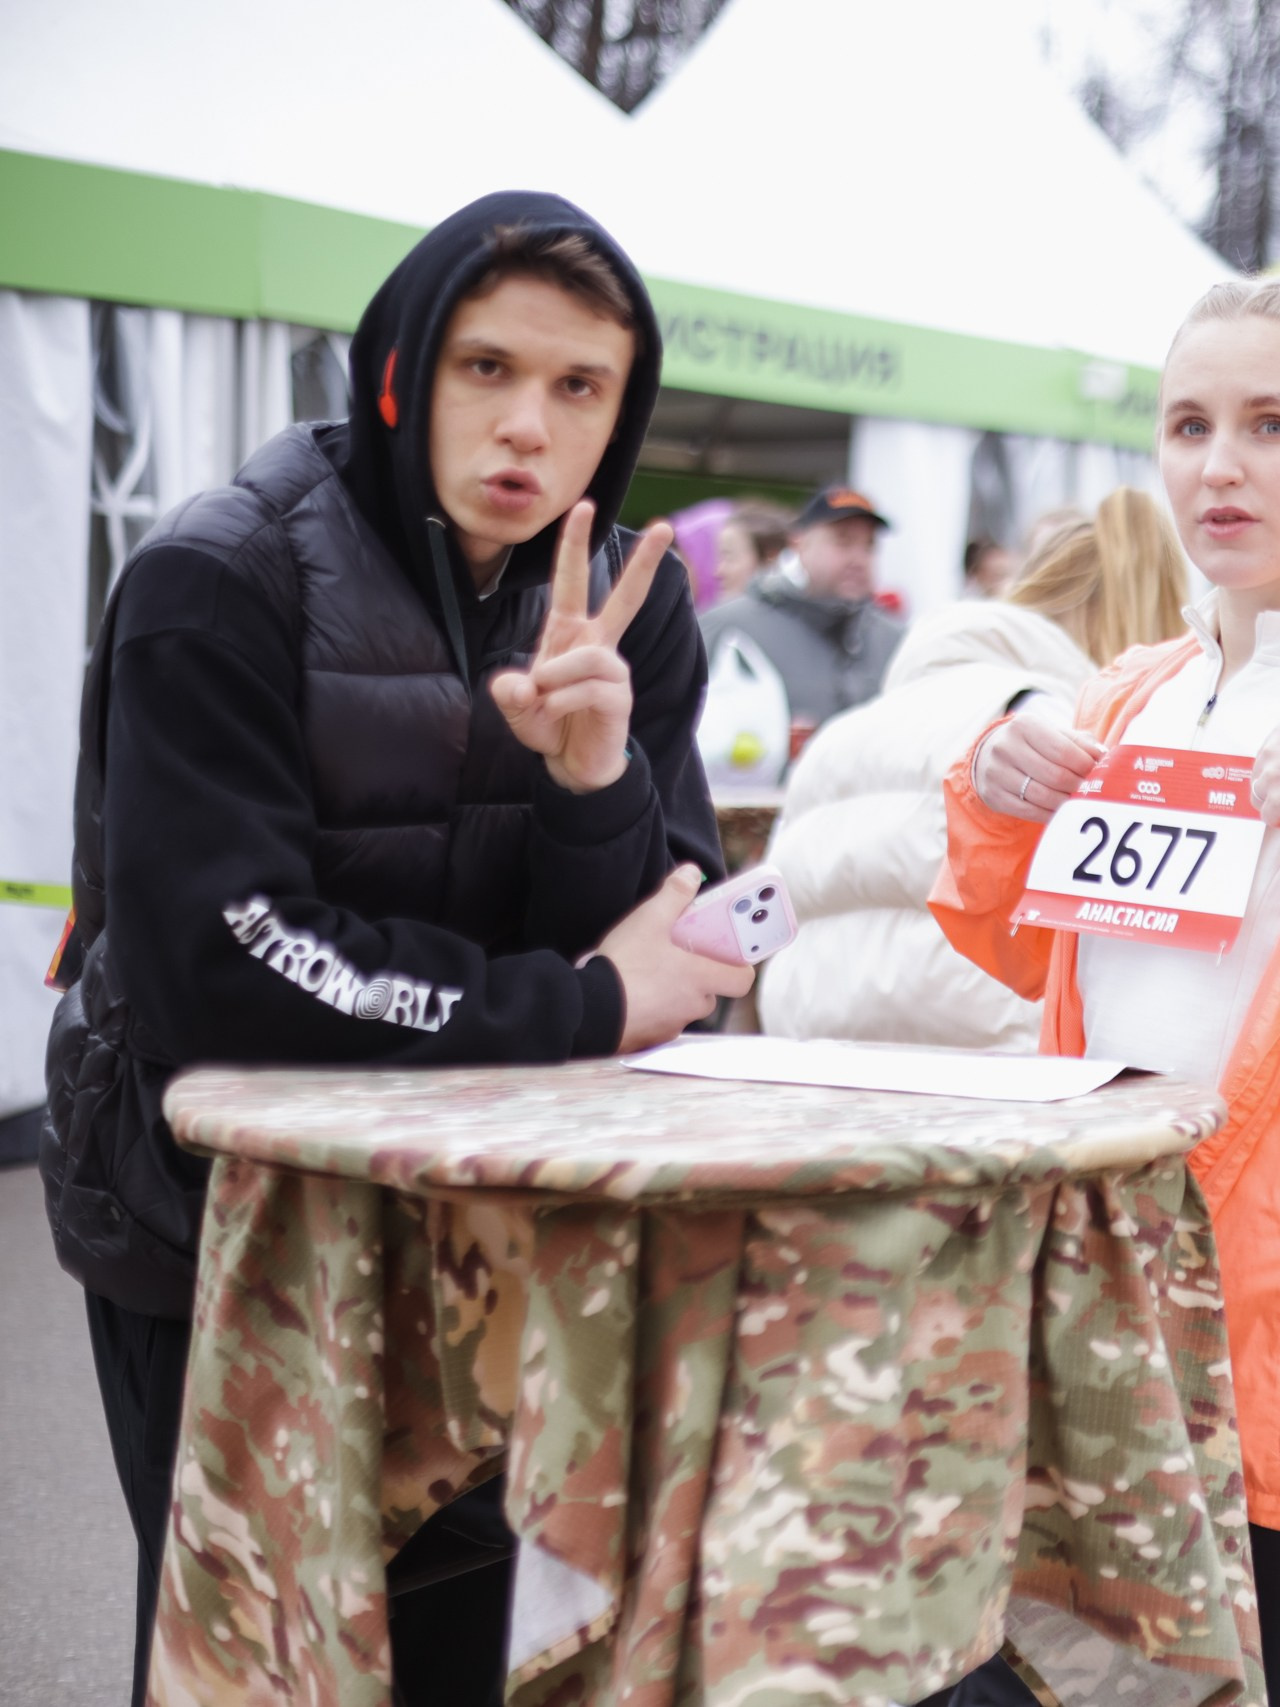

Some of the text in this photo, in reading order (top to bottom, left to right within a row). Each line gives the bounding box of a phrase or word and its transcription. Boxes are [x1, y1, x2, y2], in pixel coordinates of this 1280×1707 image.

[1208, 790, 1237, 807] MIR
[1072, 816, 1218, 895] 2677
[1075, 902, 1180, 933] АНАСТАСИЯ
